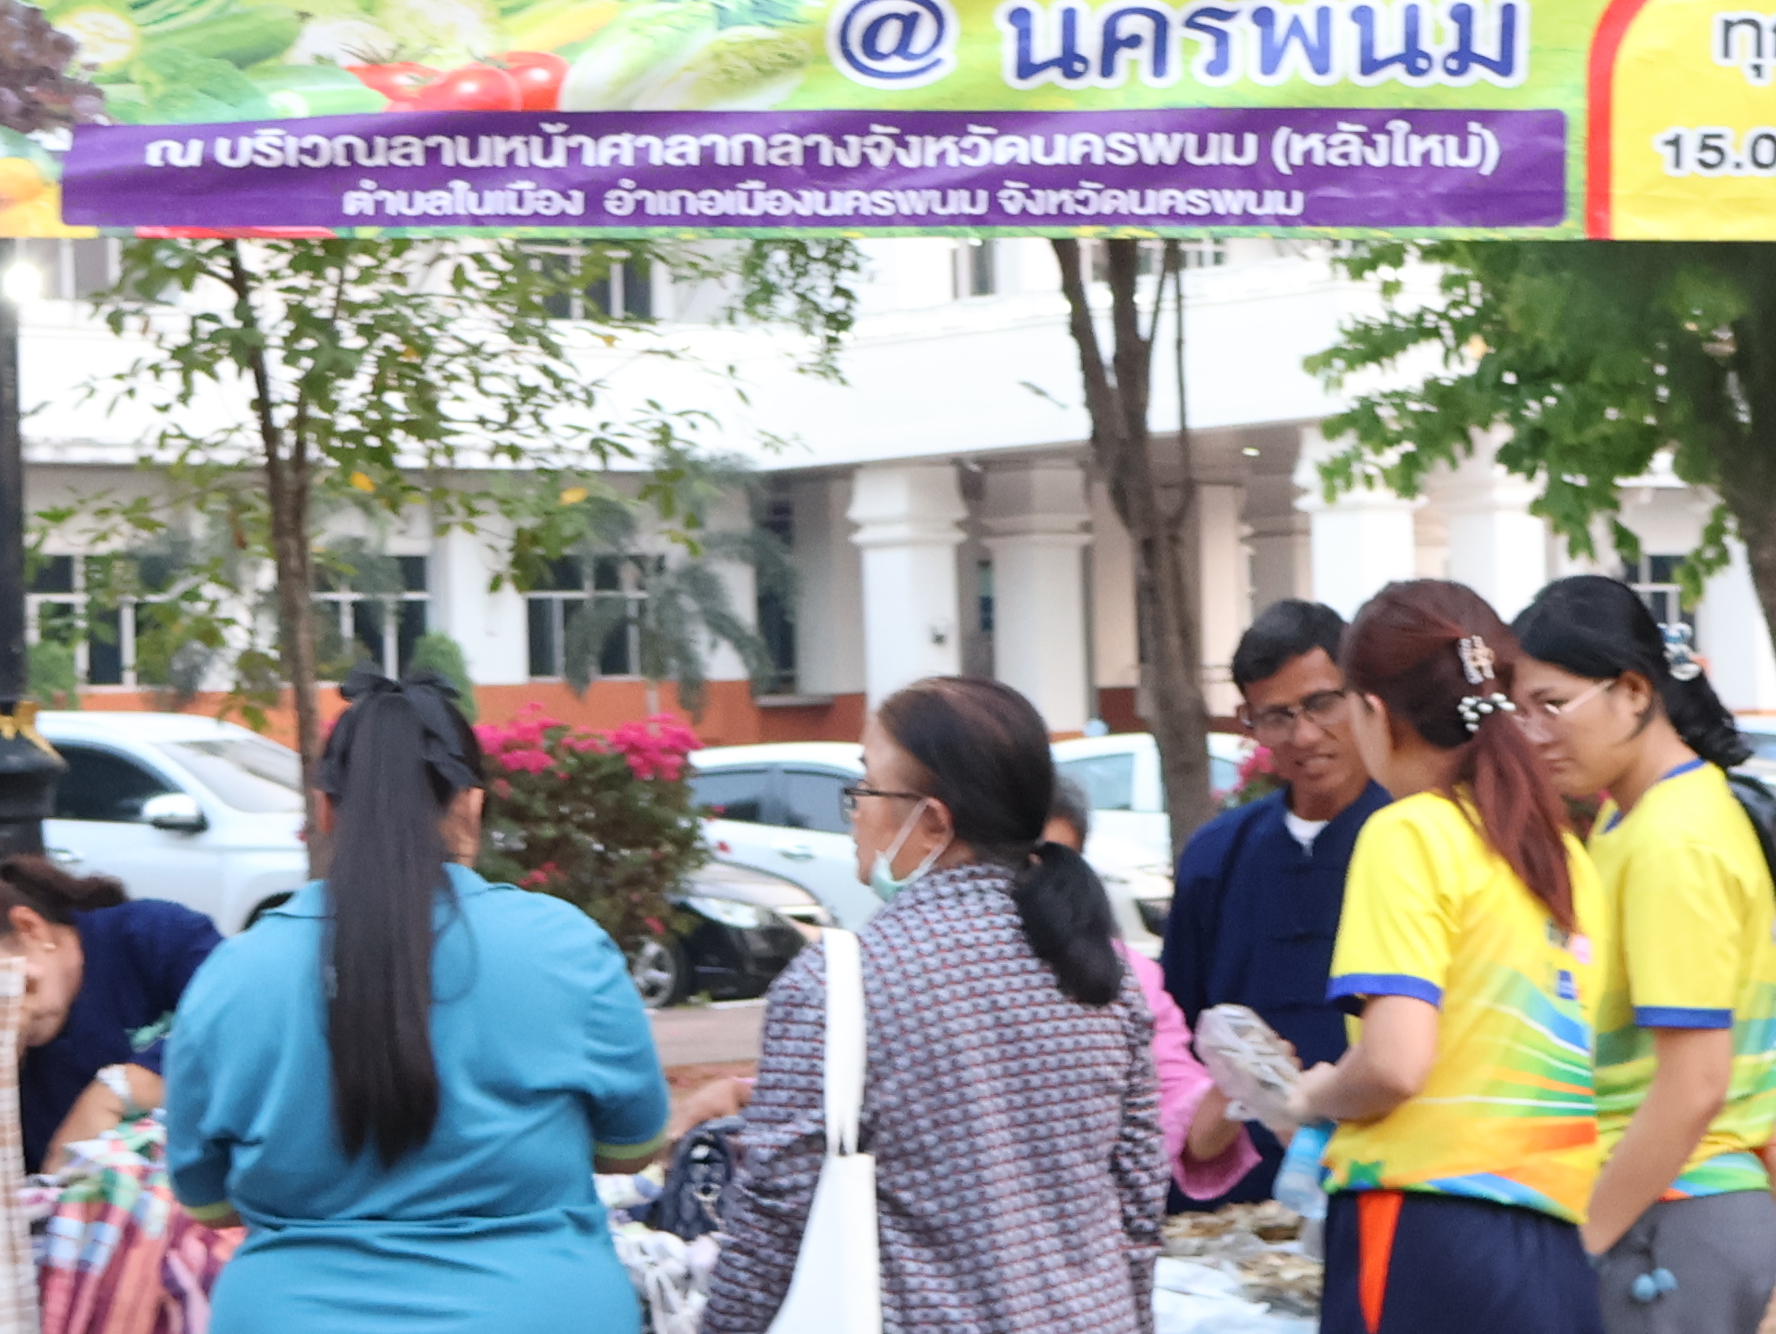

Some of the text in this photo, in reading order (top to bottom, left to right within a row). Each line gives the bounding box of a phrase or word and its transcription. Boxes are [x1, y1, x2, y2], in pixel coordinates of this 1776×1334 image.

[145, 120, 1500, 176] ณ บริเวณลานหน้าศาลากลางจังหวัดนครพนม (หลังใหม่)
[996, 180, 1304, 217] จังหวัดนครพนม
